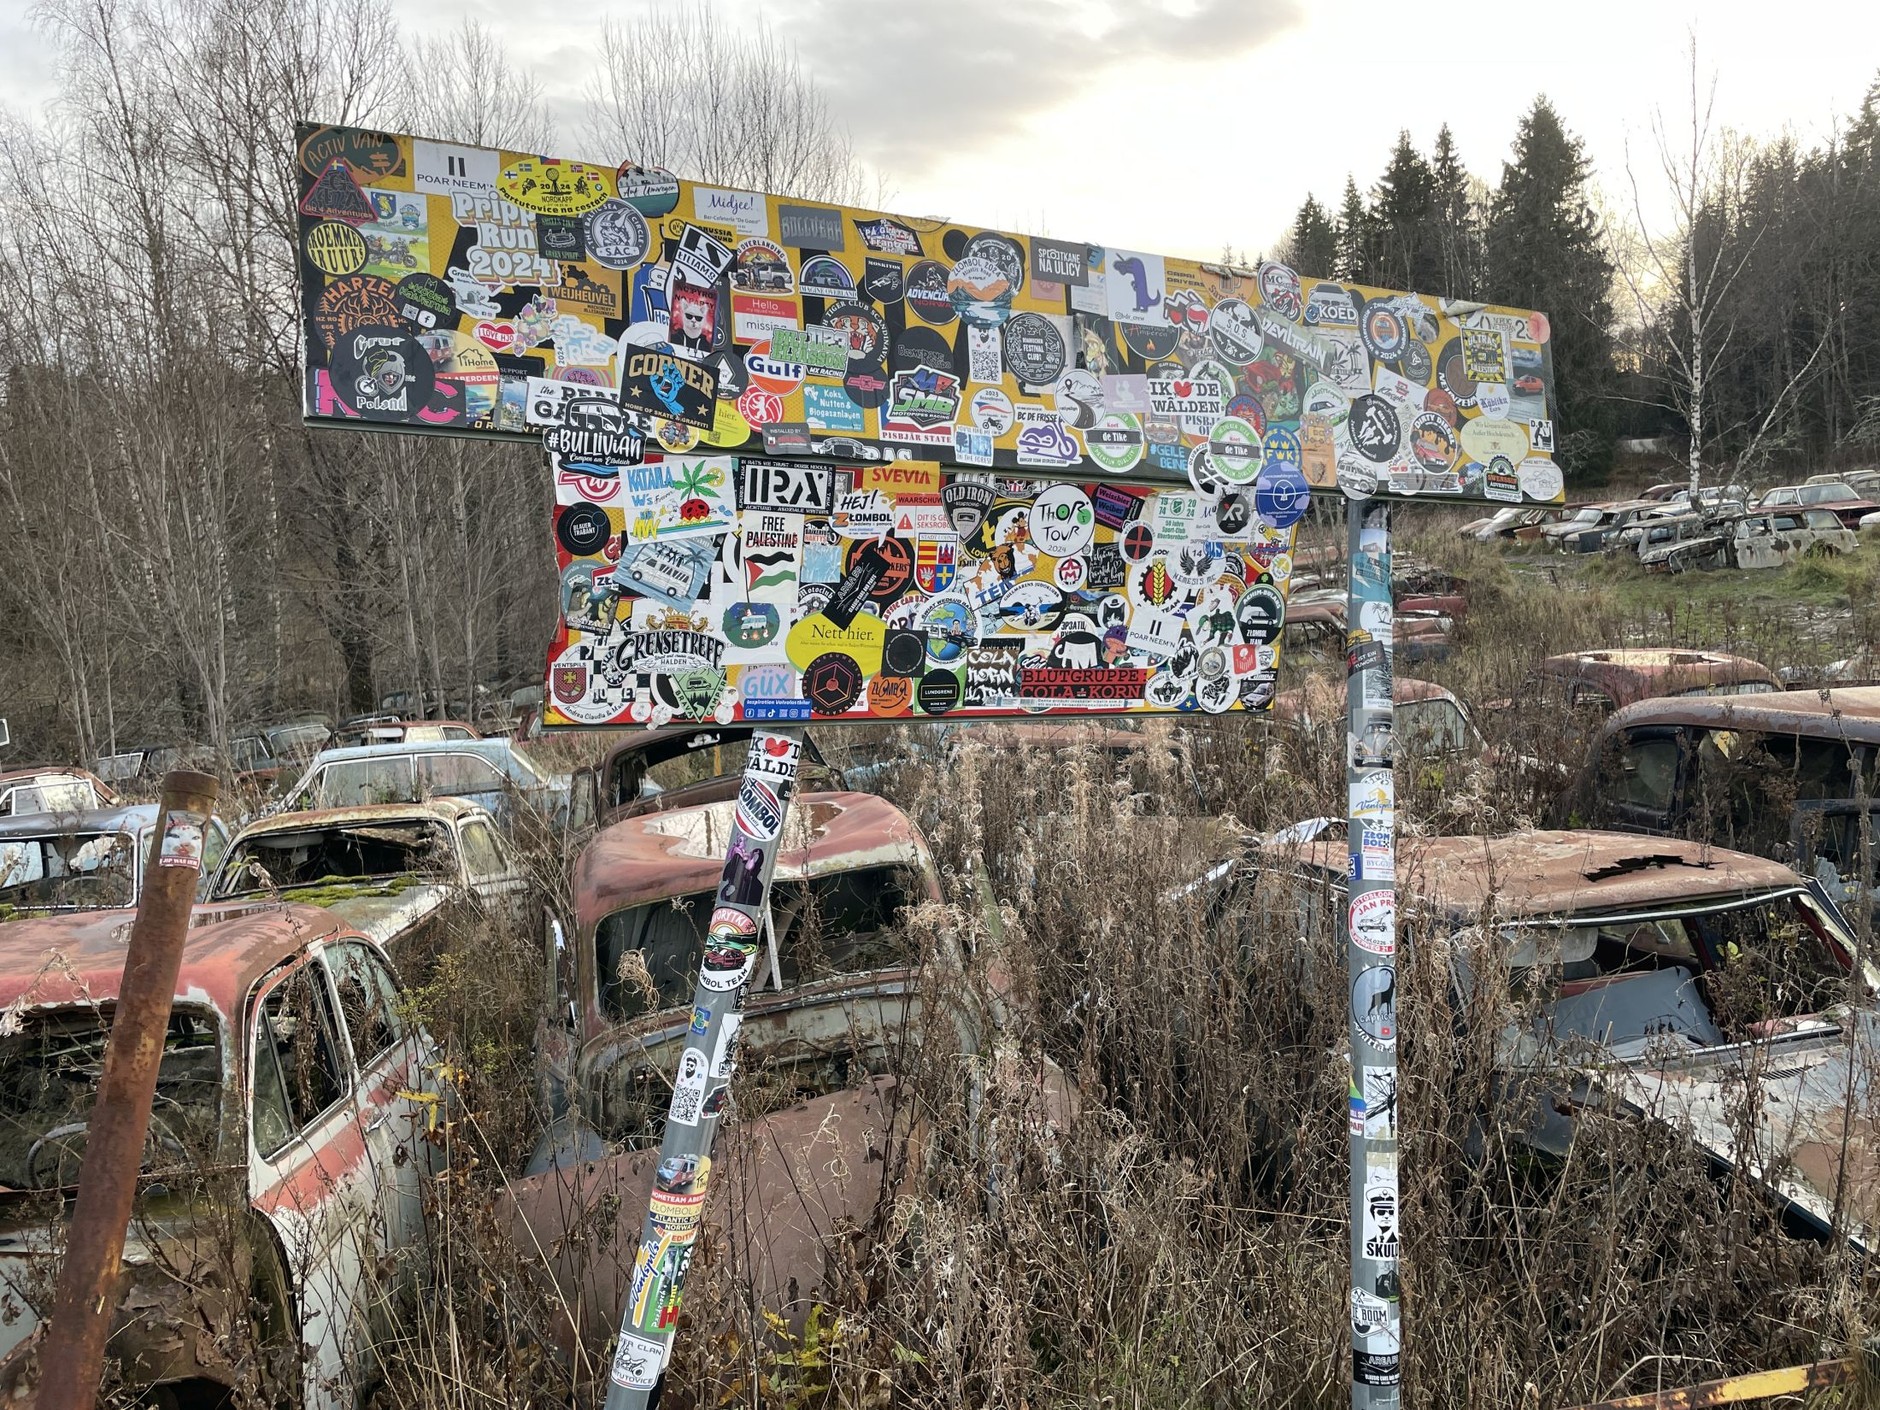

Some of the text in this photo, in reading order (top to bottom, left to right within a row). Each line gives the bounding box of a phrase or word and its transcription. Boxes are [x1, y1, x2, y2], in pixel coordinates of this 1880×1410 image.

[307, 133, 385, 167] ACTIV VAN
[417, 174, 449, 185] POAR
[499, 187, 558, 214] Partutovice
[575, 192, 608, 212] cestách
[708, 194, 753, 215] Midjee!
[584, 202, 645, 246] THE BALTIC SEA CIRCLE
[480, 222, 537, 250] Run
[740, 241, 785, 259] OVERLANDING
[470, 250, 554, 278] 2024
[953, 258, 1001, 277] ZŁOMBOL 2024
[1039, 260, 1081, 277] NA ULICY
[1167, 270, 1195, 280] CAPRI
[1167, 277, 1205, 288] DRIVERS
[1266, 275, 1283, 284] MC
[324, 277, 396, 303] HARZE
[551, 287, 615, 306] WEIJHEUVEL
[752, 299, 779, 311] Hello
[1319, 304, 1357, 321] KOED
[482, 329, 498, 340] LOVE
[826, 300, 890, 363] TIGER CLUB SCANDINAVIA
[1380, 351, 1397, 360] 2024
[500, 367, 527, 375] SUPPORT
[748, 356, 801, 379] Gulf
[810, 367, 843, 378] MX RACING
[455, 374, 499, 383] ABERDEEN
[540, 385, 556, 395] the
[824, 389, 844, 399] Koks,
[1150, 381, 1219, 397] IK DE
[357, 388, 408, 411] Poland
[820, 399, 845, 408] Nutten
[895, 389, 955, 412] SMB
[1153, 397, 1221, 413] WÂLDEN
[625, 402, 643, 411] HOME
[654, 410, 674, 420] SKATE
[682, 417, 709, 428] GRAFFITI
[1017, 411, 1057, 424] BC DE FRISSE
[882, 430, 922, 441] PISBJÄR
[1102, 430, 1127, 442] de Tike
[1414, 414, 1455, 445] DIRTY DIESEL
[1094, 447, 1136, 469] PREMIUM QUALITY
[1150, 444, 1185, 458] #GEILE
[1225, 445, 1248, 456] de Tike
[872, 466, 931, 485] SVEVIA
[840, 489, 878, 511] HEJ!
[946, 487, 992, 506] OLD IRON
[1099, 488, 1131, 506] Weissbier
[1160, 498, 1196, 508] 19 20
[1098, 501, 1124, 515] Weiber
[1158, 506, 1195, 517] 74 24
[573, 521, 593, 530] BLAUER
[762, 516, 785, 531] FREE
[832, 512, 892, 528] ZŁOMBOL
[574, 527, 596, 536] TRABANT
[747, 531, 797, 548] PALESTINE
[1048, 544, 1066, 553] 2024
[1192, 549, 1202, 557] 14
[1172, 572, 1217, 585] NEMESIS MC
[1161, 600, 1181, 613] TEAM
[812, 624, 875, 641] Nett hier.
[1129, 631, 1177, 649] POAR NEEM'N
[616, 631, 725, 671] GRENSETREFF
[968, 650, 1016, 666] COLA
[967, 666, 1015, 684] KORN
[744, 669, 790, 698] GÜX
[872, 679, 908, 698] ZŁOMBOL
[1021, 685, 1141, 698] COLA KORN
[707, 680, 727, 717] CAMPER
[964, 684, 1013, 703] ULTRAS
[675, 689, 694, 717] BRAVA
[564, 705, 606, 720] Andrea Claudia
[1364, 831, 1390, 840] ZŁOM
[1358, 901, 1377, 916] JAN
[725, 968, 748, 987] TEAM
[651, 1202, 692, 1216] ZŁOMBOL
[655, 1214, 690, 1223] ATLANTIC
[1362, 1308, 1388, 1322] BOOM
[637, 1344, 662, 1356] CLAN
